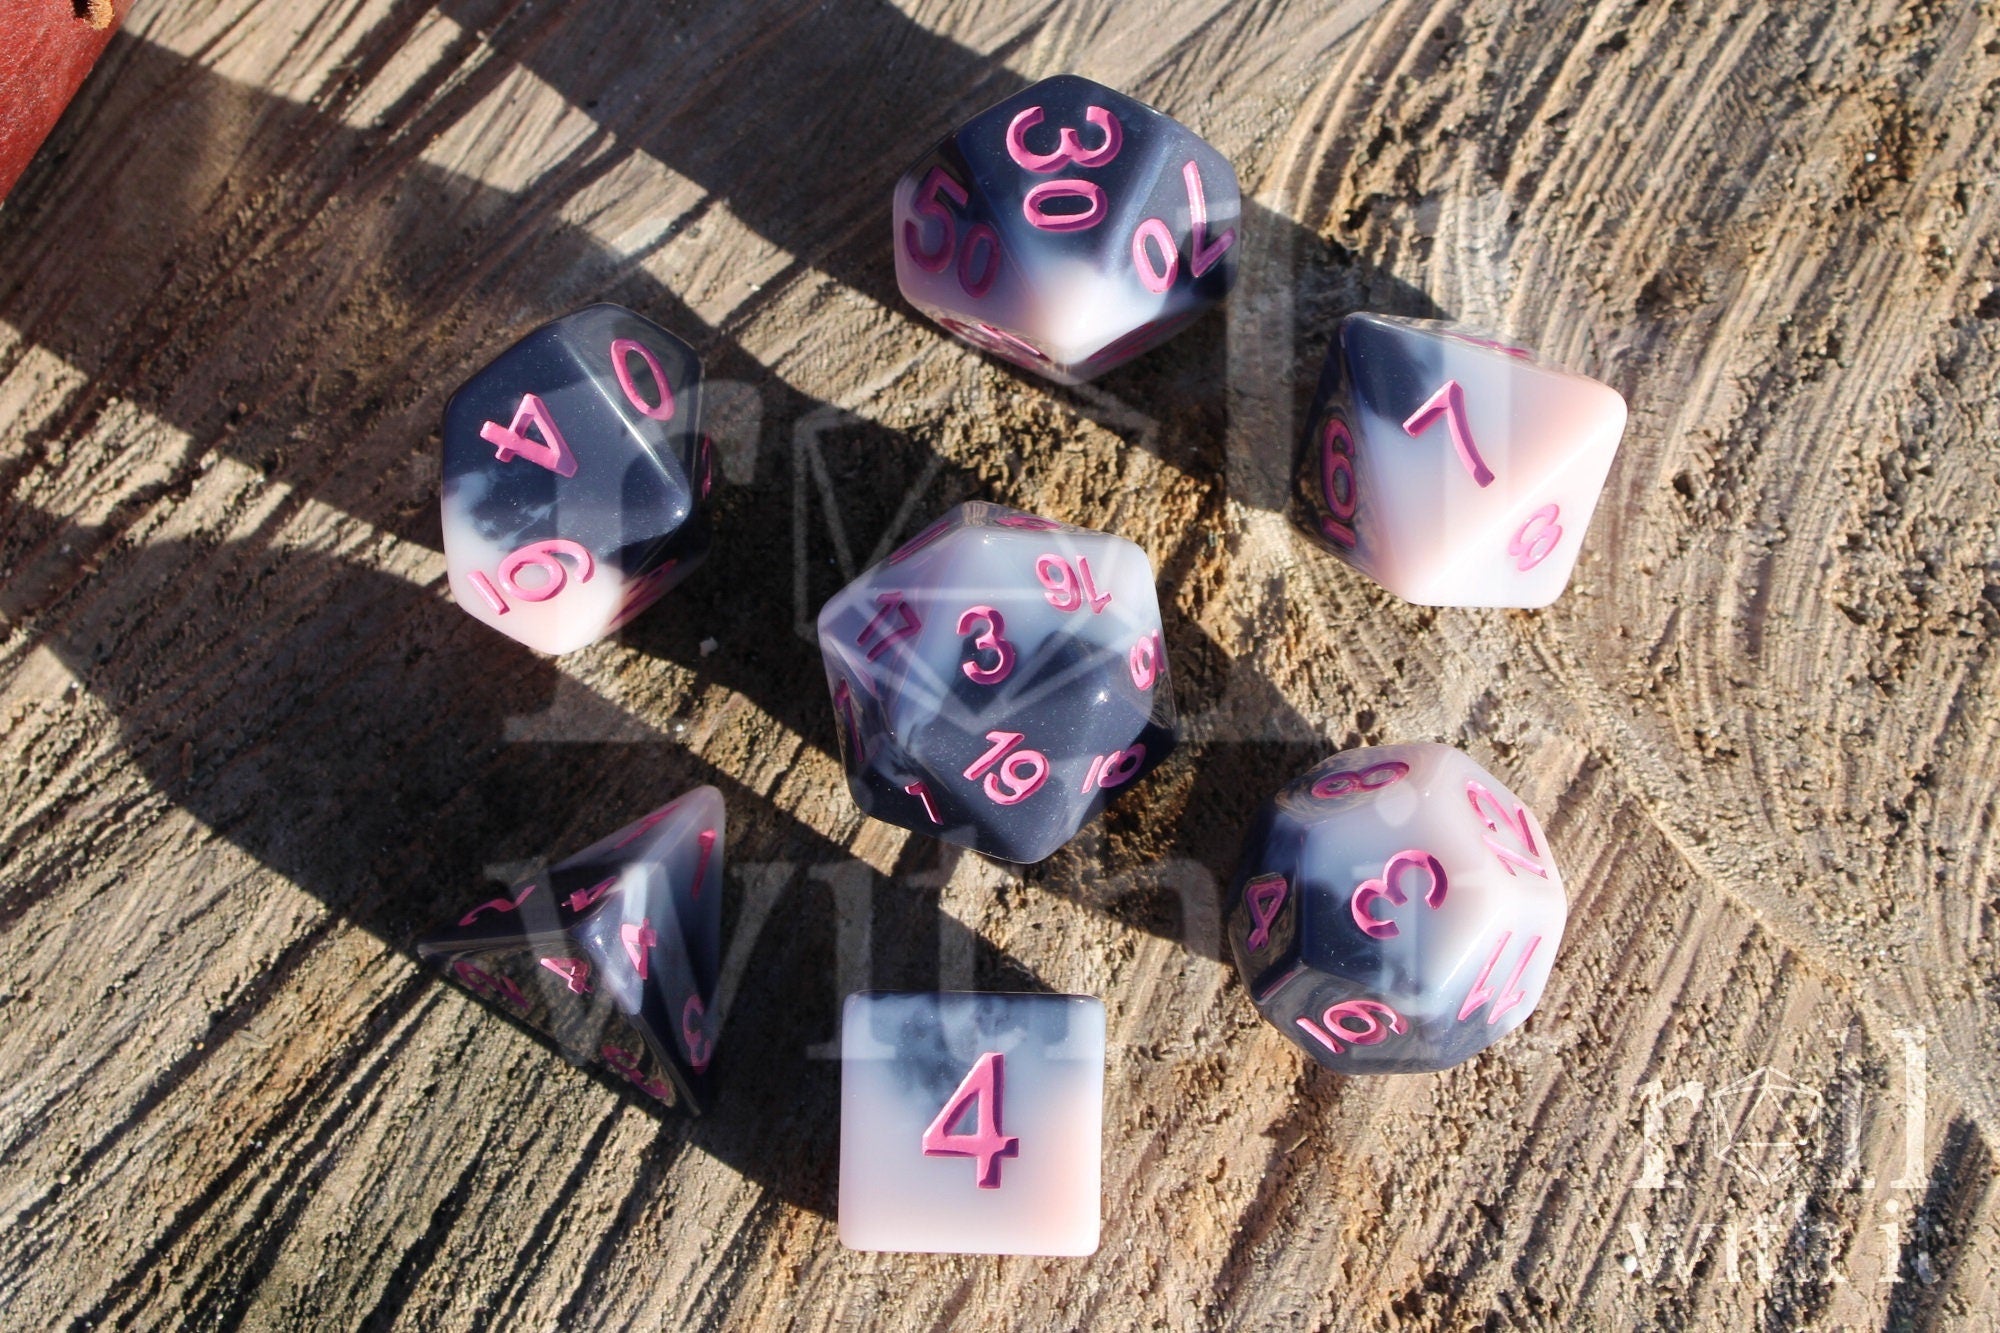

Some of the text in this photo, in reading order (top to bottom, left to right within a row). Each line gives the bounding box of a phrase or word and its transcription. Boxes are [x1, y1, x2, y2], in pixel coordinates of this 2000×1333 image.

[1006, 106, 1123, 232] 30
[905, 166, 1000, 298] 50
[1133, 160, 1236, 294] 70
[611, 338, 676, 421] 0
[480, 393, 578, 478] 4
[1403, 380, 1495, 488] 7
[1508, 503, 1563, 571] 8
[1036, 553, 1112, 615] 16
[957, 605, 1016, 685] 3
[963, 731, 1050, 806] 19
[1311, 761, 1409, 799] 8
[1245, 876, 1288, 950] 4
[1351, 849, 1448, 940] 3
[621, 918, 657, 980] 4
[1457, 931, 1541, 1024] 11
[922, 1052, 1019, 1189] 4
